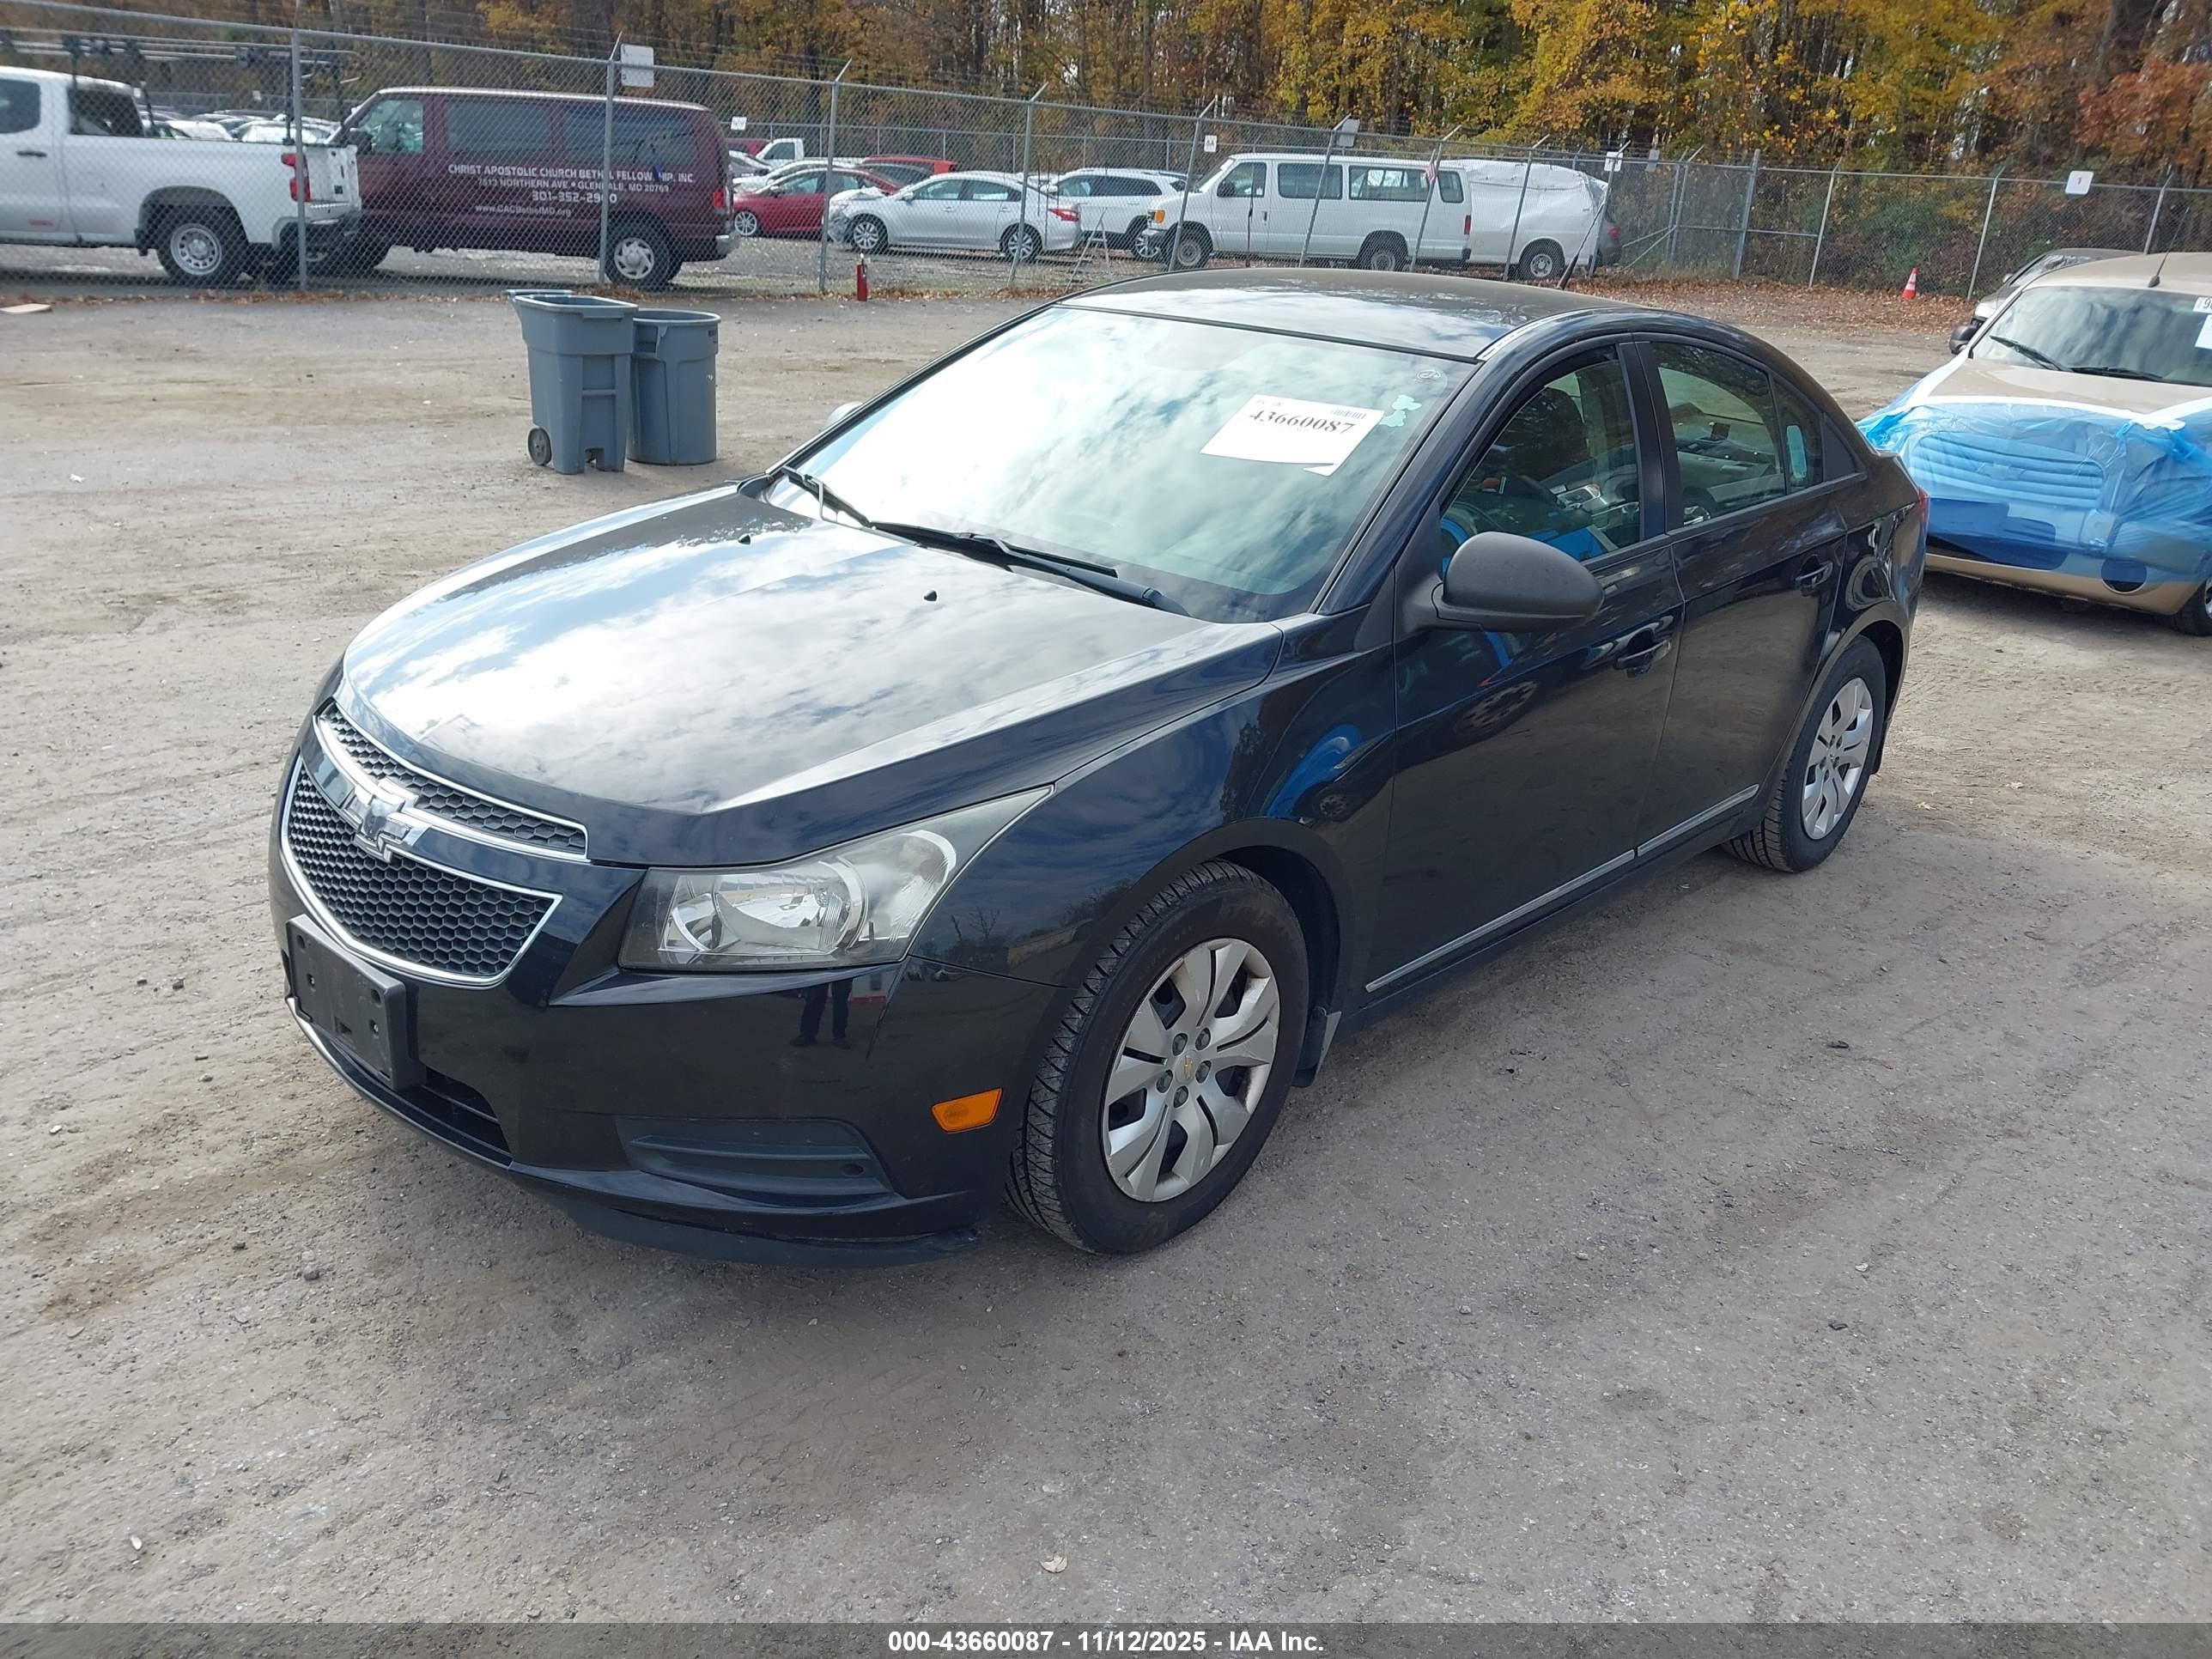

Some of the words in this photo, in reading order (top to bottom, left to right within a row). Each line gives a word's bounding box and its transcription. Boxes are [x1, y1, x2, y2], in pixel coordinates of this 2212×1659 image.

[448, 164, 481, 174] CHRIST
[484, 165, 538, 177] APOSTOLIC
[539, 167, 577, 179] CHURCH
[579, 169, 614, 179] BETHL
[500, 178, 550, 188] NORTHERN
[532, 190, 617, 204] 301-352-290
[1250, 410, 1356, 434] 43660087
